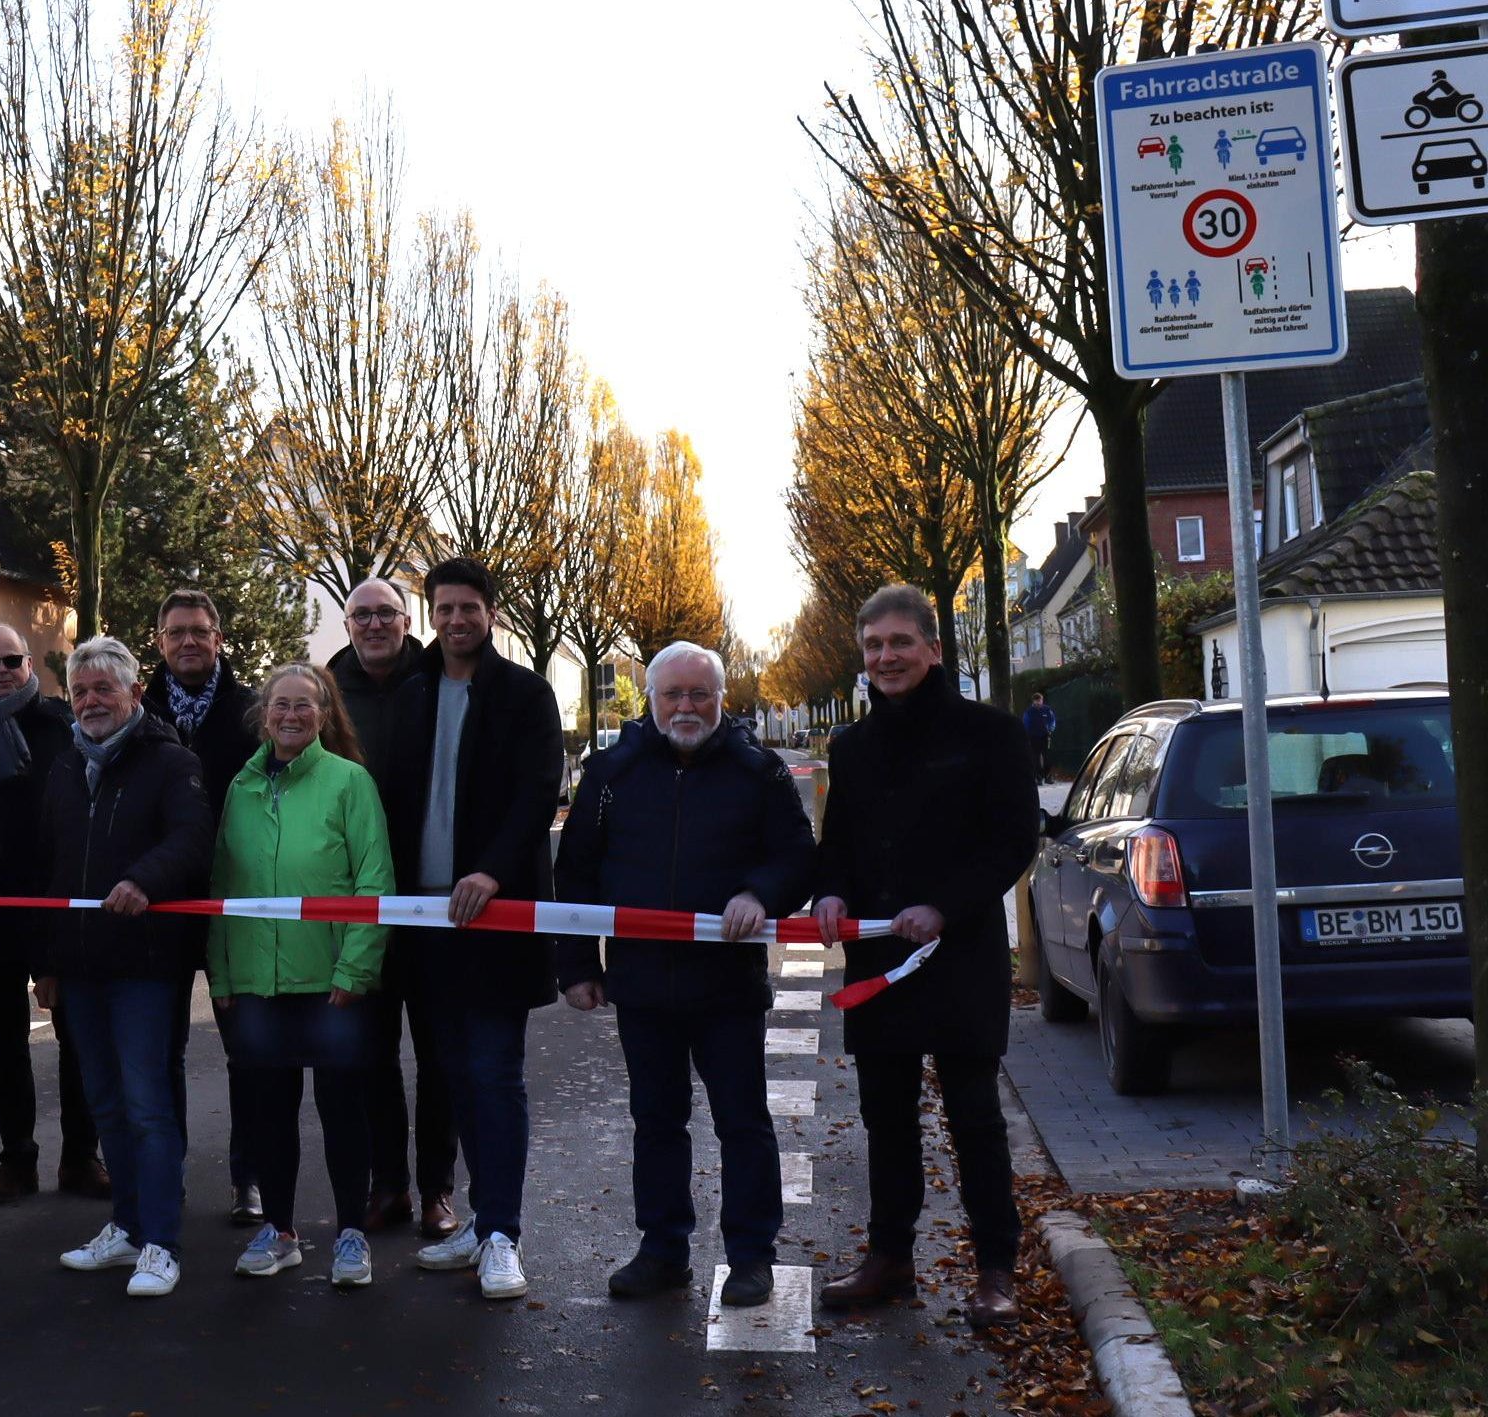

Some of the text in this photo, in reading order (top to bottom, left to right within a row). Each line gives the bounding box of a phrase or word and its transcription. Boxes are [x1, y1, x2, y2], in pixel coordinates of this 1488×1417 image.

[1120, 61, 1299, 101] Fahrradstraße
[1150, 101, 1274, 126] Zu beachten ist:
[1228, 174, 1247, 182] Mind.
[1268, 168, 1296, 178] Abstand
[1131, 182, 1173, 192] Radfahrende
[1246, 180, 1279, 190] einhalten
[1150, 190, 1179, 199] Vorrang!
[1198, 207, 1241, 240] 30
[1243, 304, 1312, 316] Radfahrende dürfen
[1154, 313, 1197, 323] Radfahrende
[1255, 316, 1276, 324] mittig
[1277, 315, 1289, 323] auf
[1139, 320, 1214, 334] dürfen nebeneinander
[1249, 322, 1309, 335] Fahrbahn fahren!
[1164, 333, 1189, 341] fahren!
[1317, 906, 1459, 936] BE BM 150
